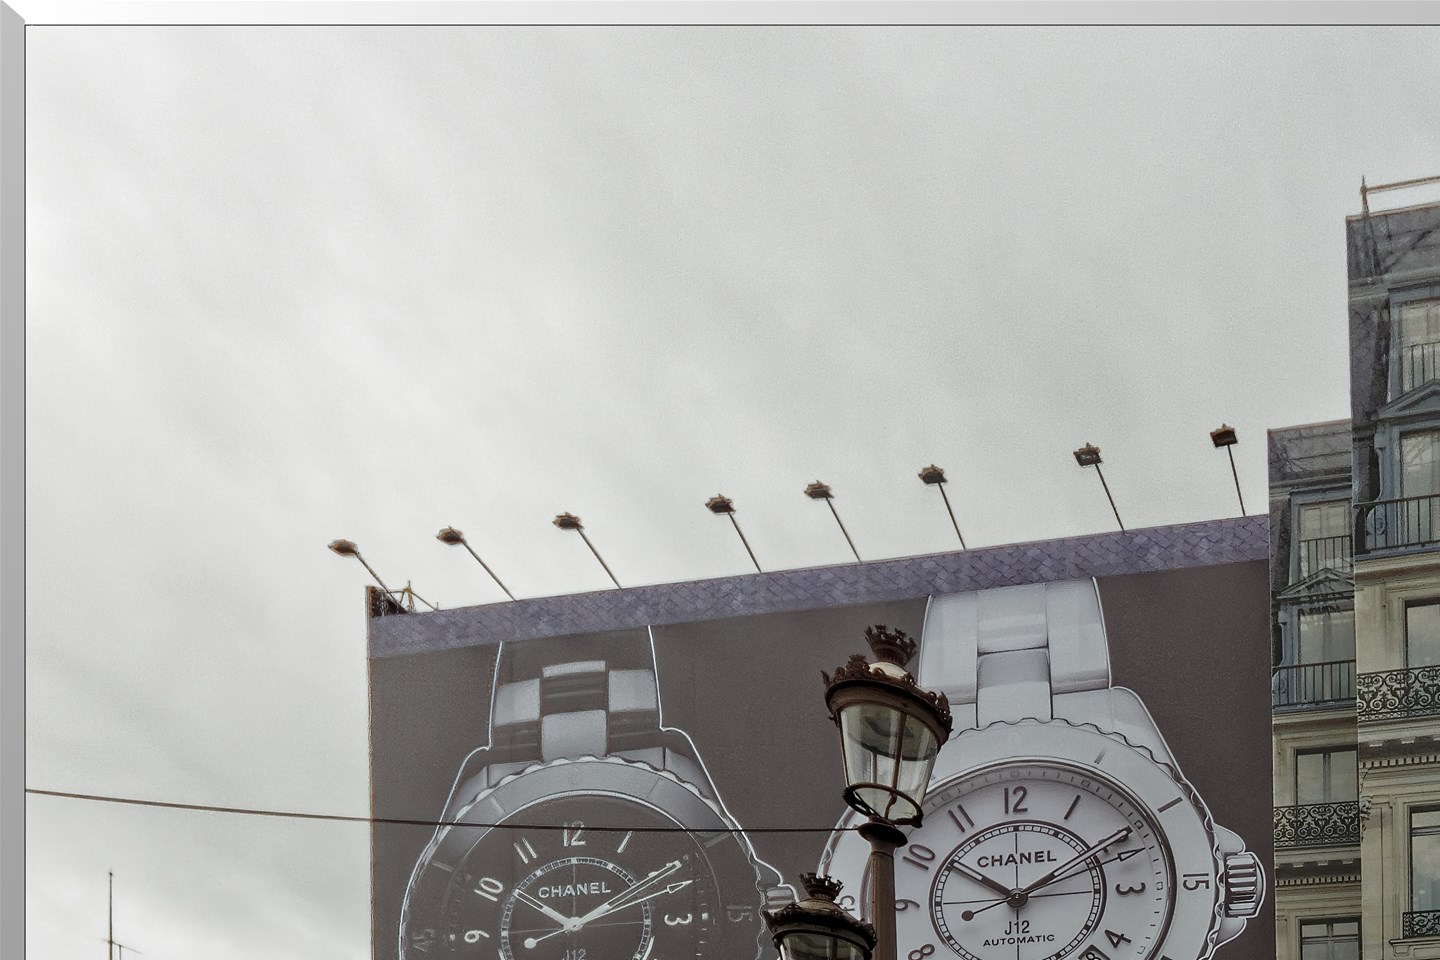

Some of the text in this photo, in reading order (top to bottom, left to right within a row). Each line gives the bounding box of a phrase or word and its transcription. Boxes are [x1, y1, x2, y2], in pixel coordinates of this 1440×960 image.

[1003, 786, 1029, 814] 12
[1063, 795, 1081, 820] 1
[947, 804, 975, 833] 11
[562, 821, 586, 847] 12
[514, 837, 537, 864] 11
[902, 843, 937, 871] 10
[977, 850, 1057, 869] CHANEL
[474, 877, 503, 901] 10
[538, 881, 611, 899] CHANEL
[1115, 882, 1146, 896] 3
[1182, 873, 1209, 891] 15
[894, 898, 920, 911] 9
[664, 913, 693, 926] 3
[1004, 920, 1030, 936] J12
[464, 930, 490, 943] 9
[983, 933, 1055, 948] AUTOMATIC
[1105, 928, 1131, 949] 4
